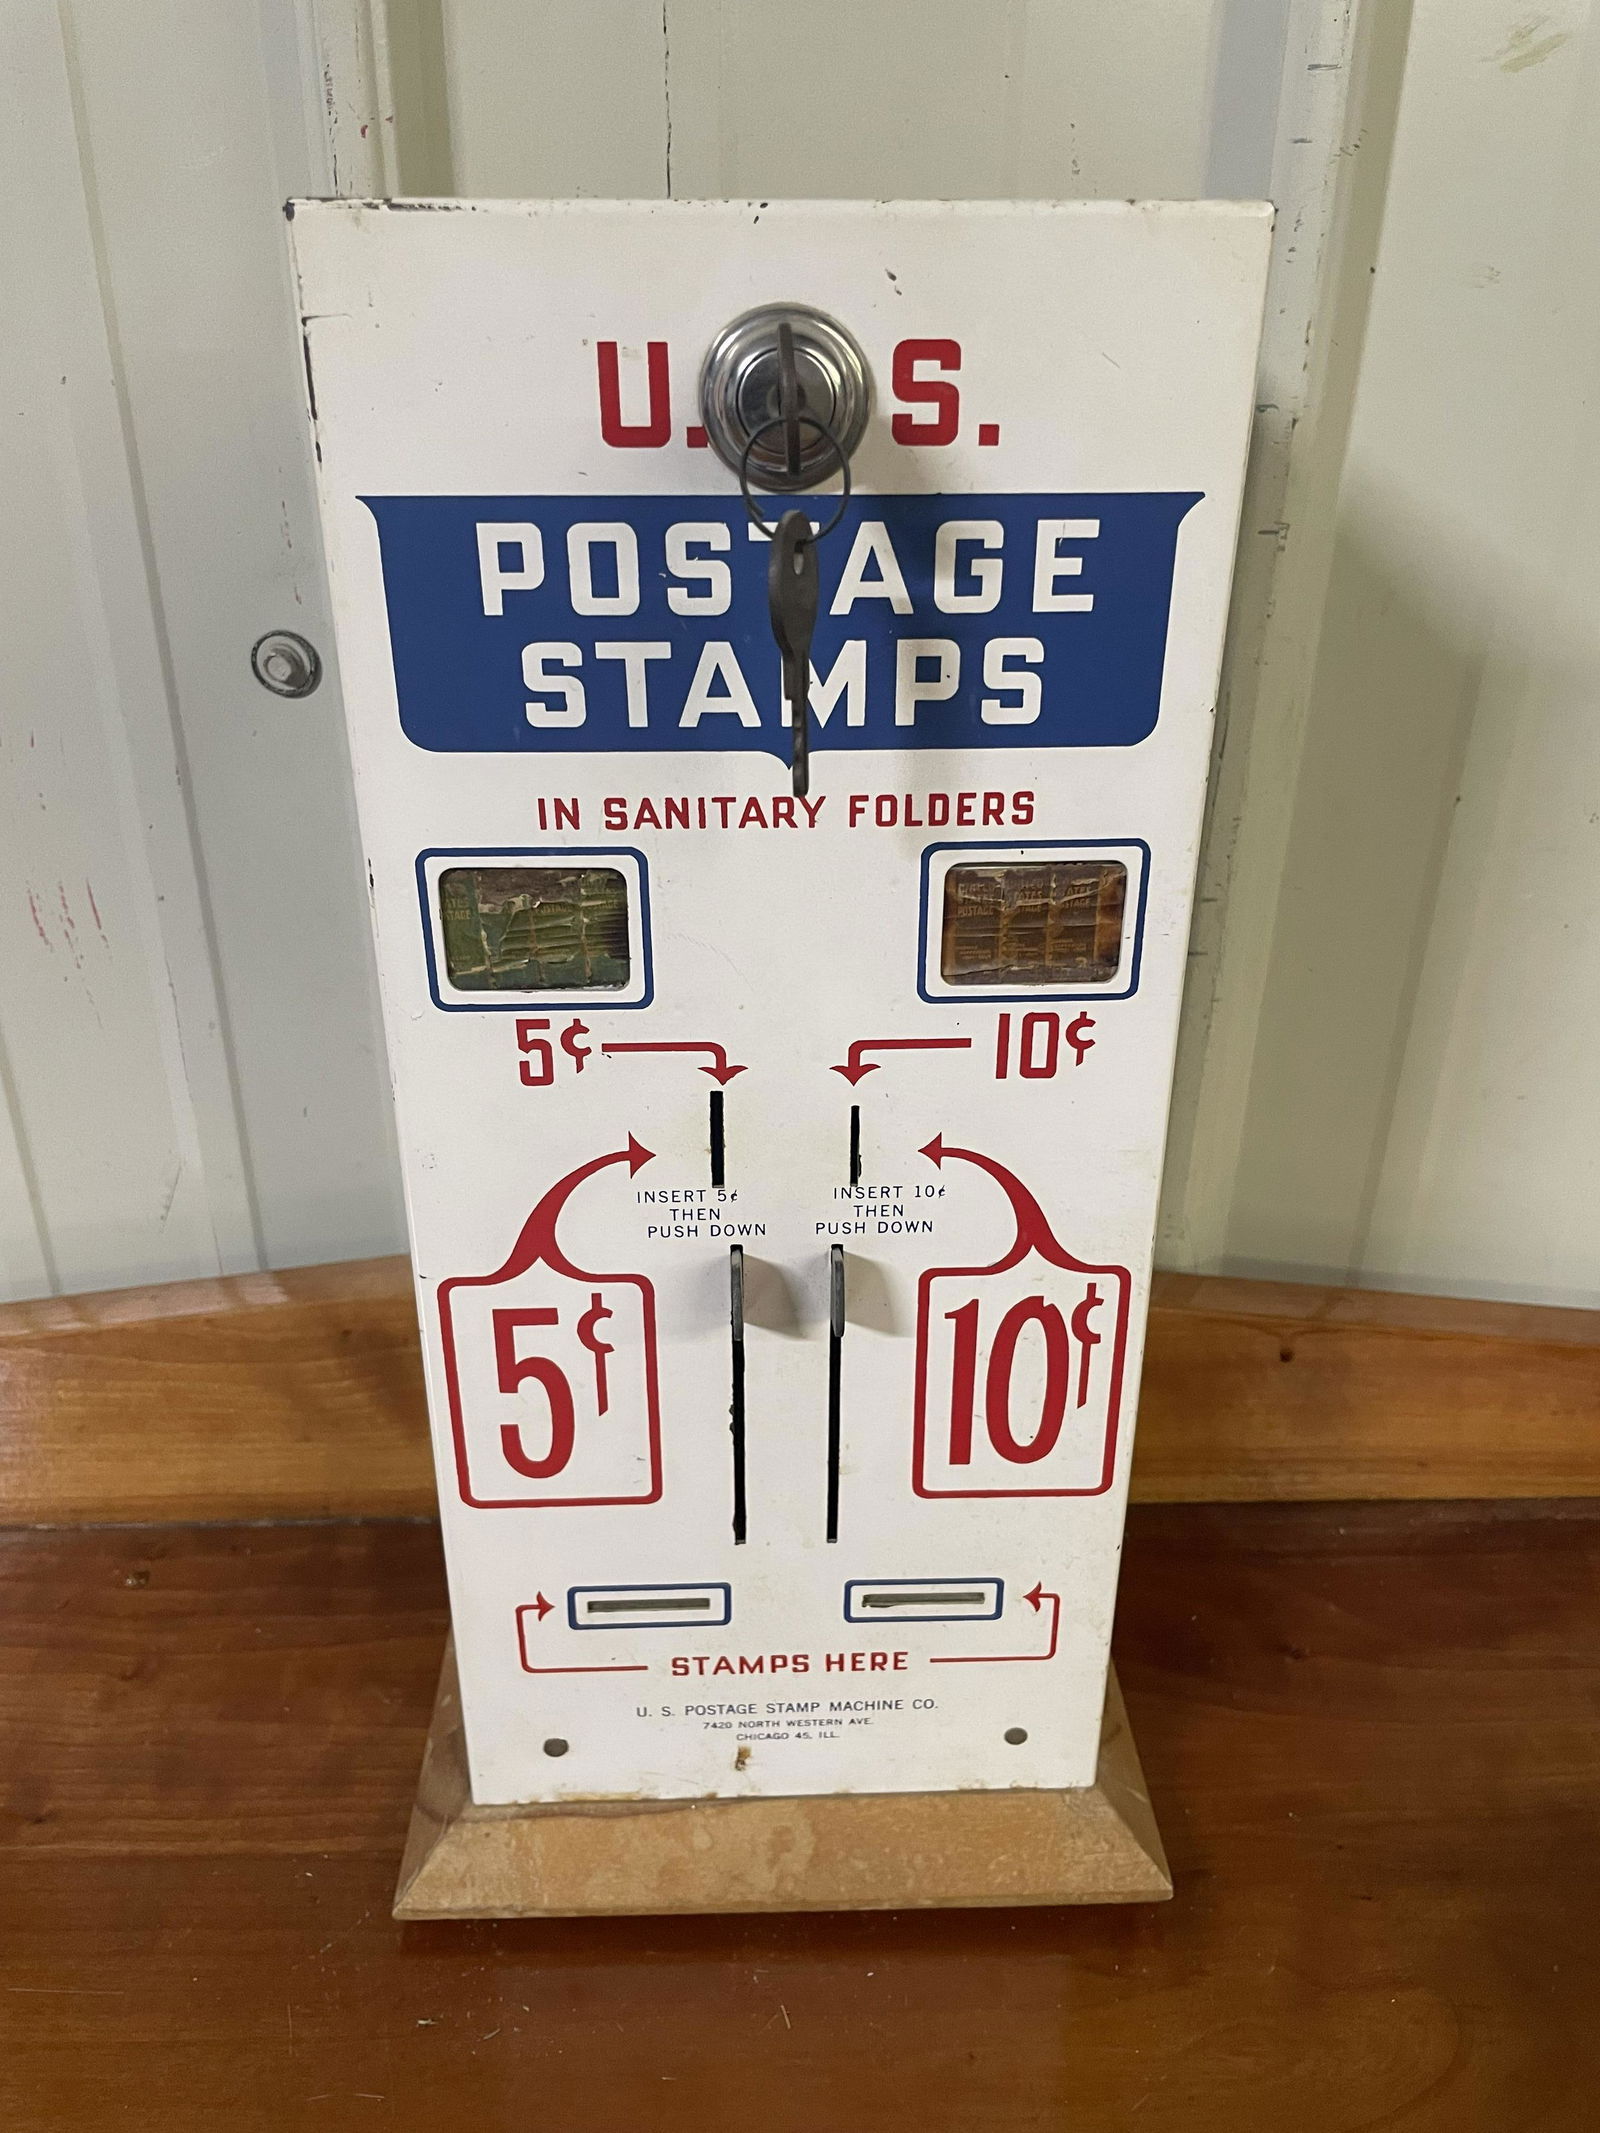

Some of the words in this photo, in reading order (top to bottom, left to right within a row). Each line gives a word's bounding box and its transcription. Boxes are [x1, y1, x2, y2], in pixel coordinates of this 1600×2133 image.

[892, 338, 1000, 447] S.
[475, 521, 1100, 615] POSAGE
[539, 798, 579, 829] IN
[604, 797, 825, 830] SANITARY
[850, 791, 1034, 827] FOLDERS
[515, 1019, 592, 1086] 5¢
[995, 1011, 1096, 1079] 10¢
[638, 1190, 706, 1203] INSERT
[717, 1188, 739, 1204] 5¢
[834, 1187, 903, 1199] INSERT
[915, 1185, 945, 1198] 10¢
[669, 1208, 720, 1221] THEN
[853, 1204, 903, 1217] THEN
[648, 1225, 698, 1238] PUSH
[710, 1224, 765, 1237] DOWN
[816, 1222, 865, 1235] PUSH
[878, 1221, 932, 1233] DOWN
[944, 1283, 1105, 1465] 10¢
[491, 1292, 615, 1479] 5¢
[672, 1655, 809, 1675] STAMPS
[825, 1652, 908, 1672] HERE
[637, 1707, 652, 1717] U.
[662, 1706, 675, 1716] S.
[685, 1704, 757, 1715] POSTAGE
[766, 1702, 820, 1713] STAMP
[830, 1700, 904, 1711] MACHINE
[913, 1699, 938, 1709] CO.
[786, 1719, 842, 1727] WESTERN
[736, 1733, 789, 1741] CHICAGO
